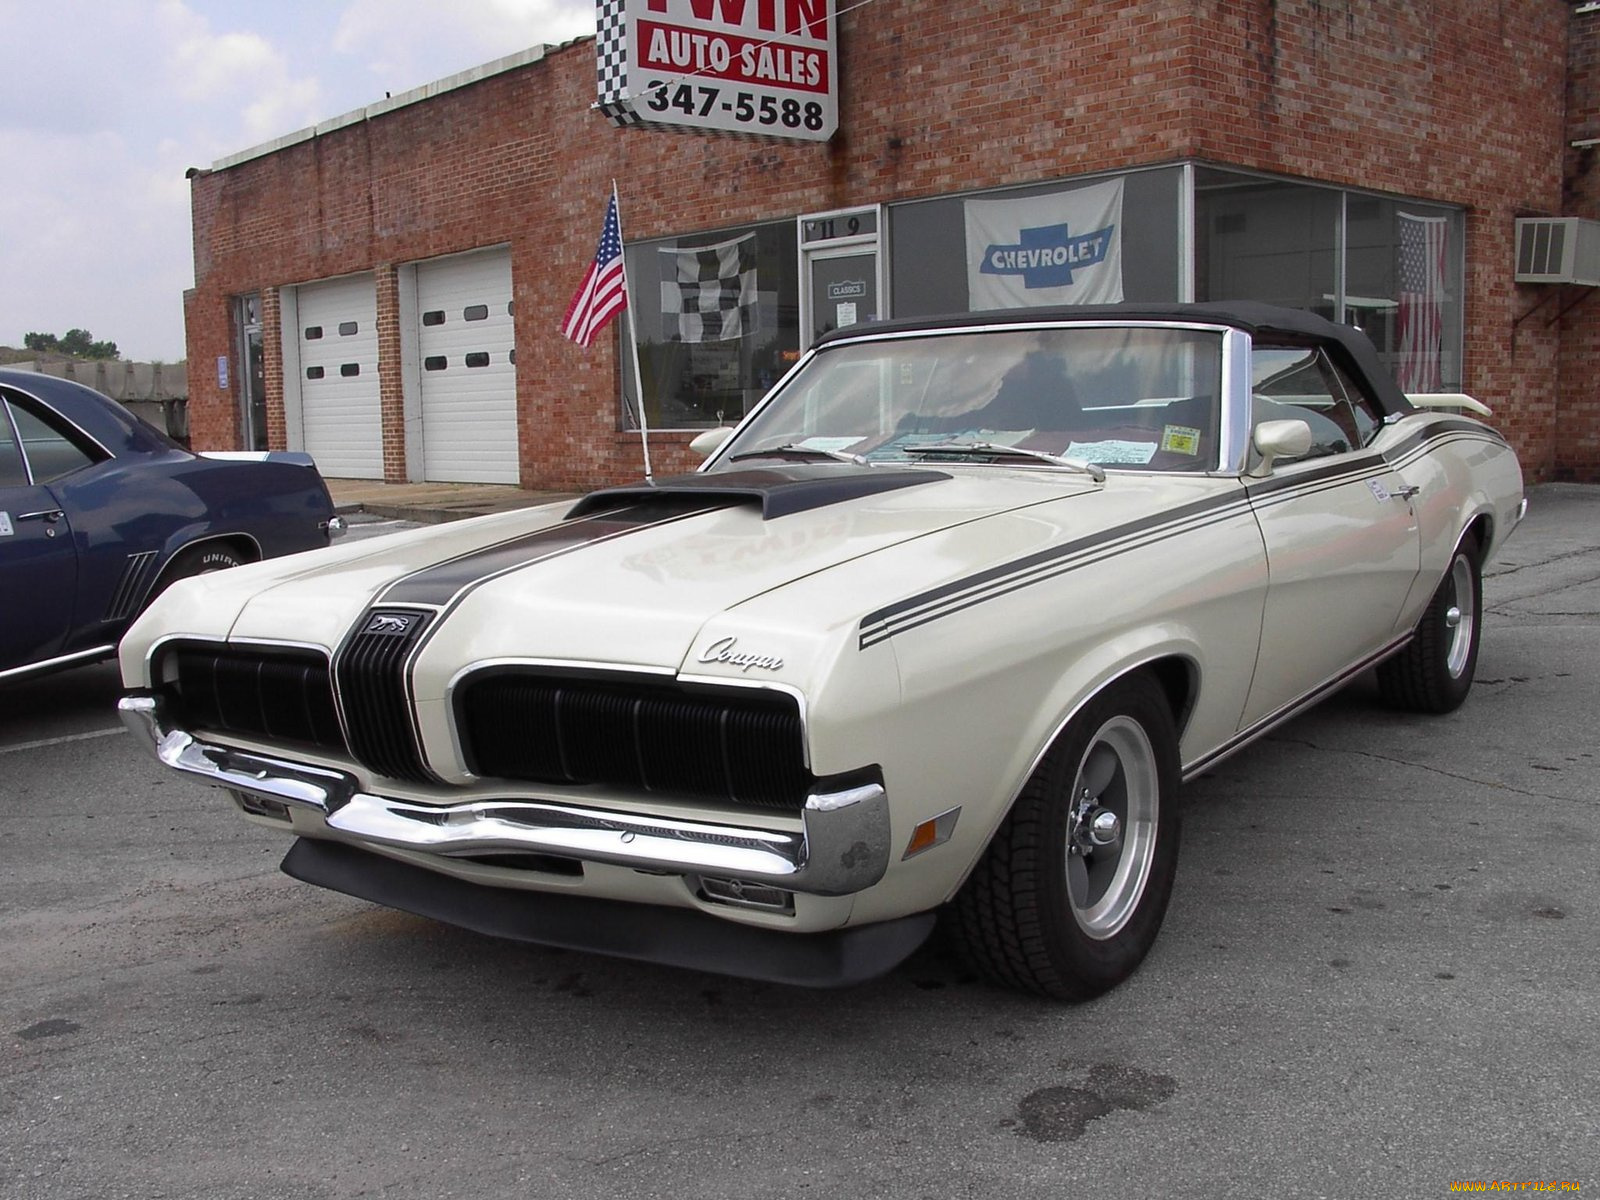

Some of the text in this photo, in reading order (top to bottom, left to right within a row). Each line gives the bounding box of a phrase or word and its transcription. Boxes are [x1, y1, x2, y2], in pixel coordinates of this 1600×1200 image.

[648, 28, 821, 86] AUTO SALES
[647, 80, 824, 131] 347-5588
[991, 237, 1103, 269] CHEVROLET
[833, 285, 861, 295] CLASSICS
[698, 636, 784, 672] Cougar
